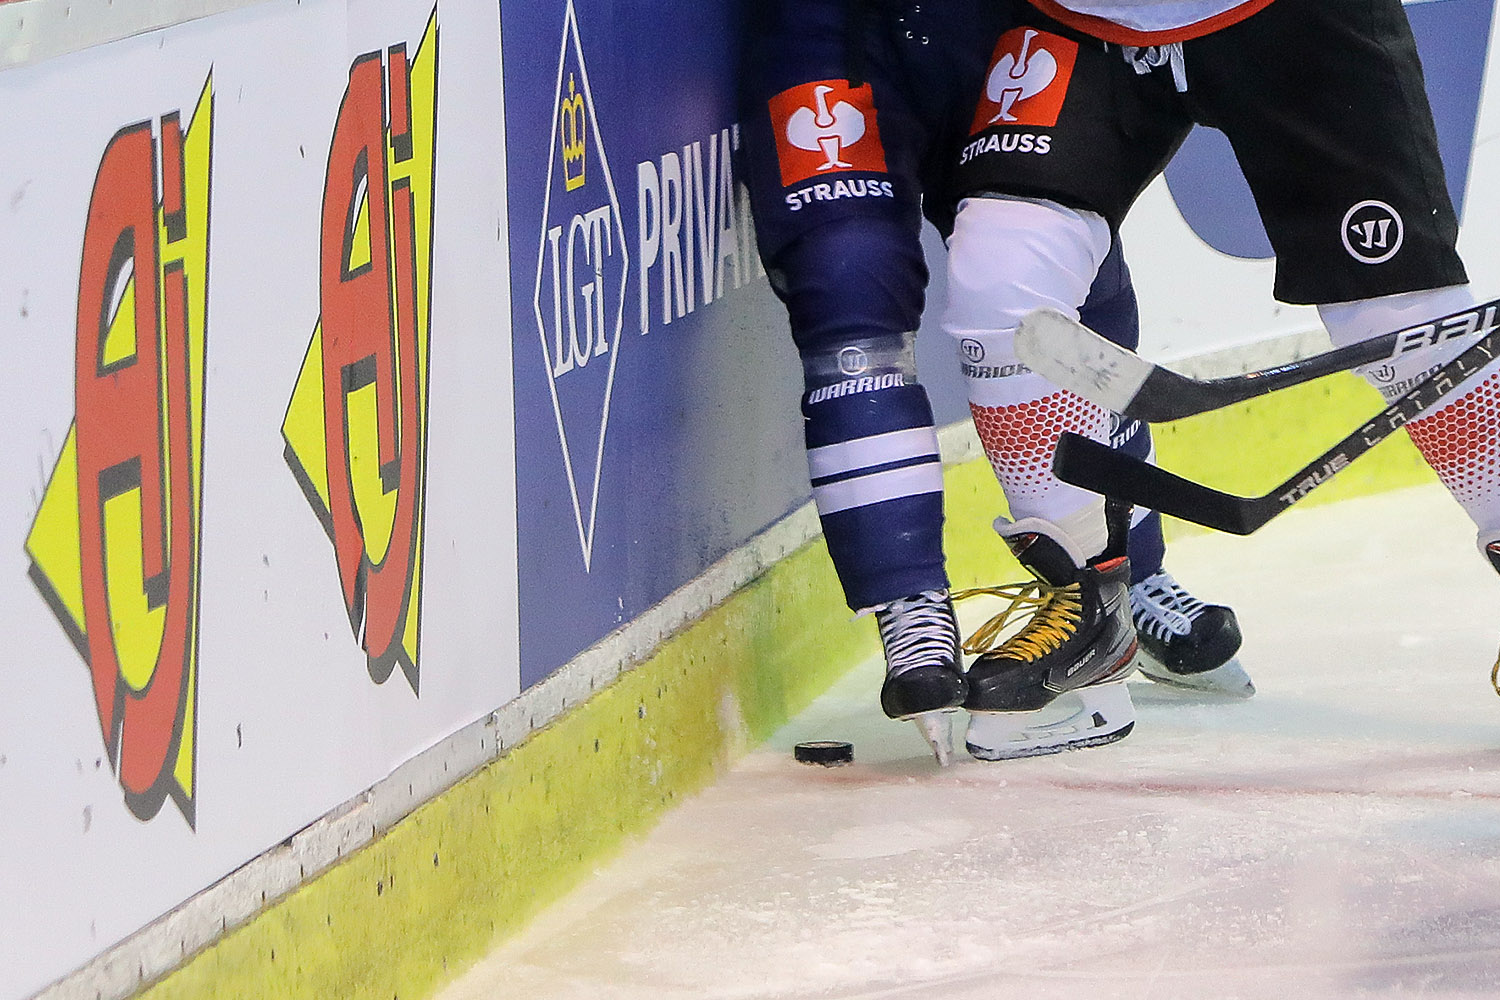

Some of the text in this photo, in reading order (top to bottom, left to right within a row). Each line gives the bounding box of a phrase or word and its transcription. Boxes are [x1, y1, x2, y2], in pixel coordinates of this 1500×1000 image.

[958, 132, 1052, 166] STRAUSS
[784, 178, 894, 212] STRAUSS
[548, 204, 612, 378] LGT
[809, 372, 905, 405] WARRIOR
[1280, 452, 1350, 507] TRUE
[1066, 648, 1098, 678] BAUER
